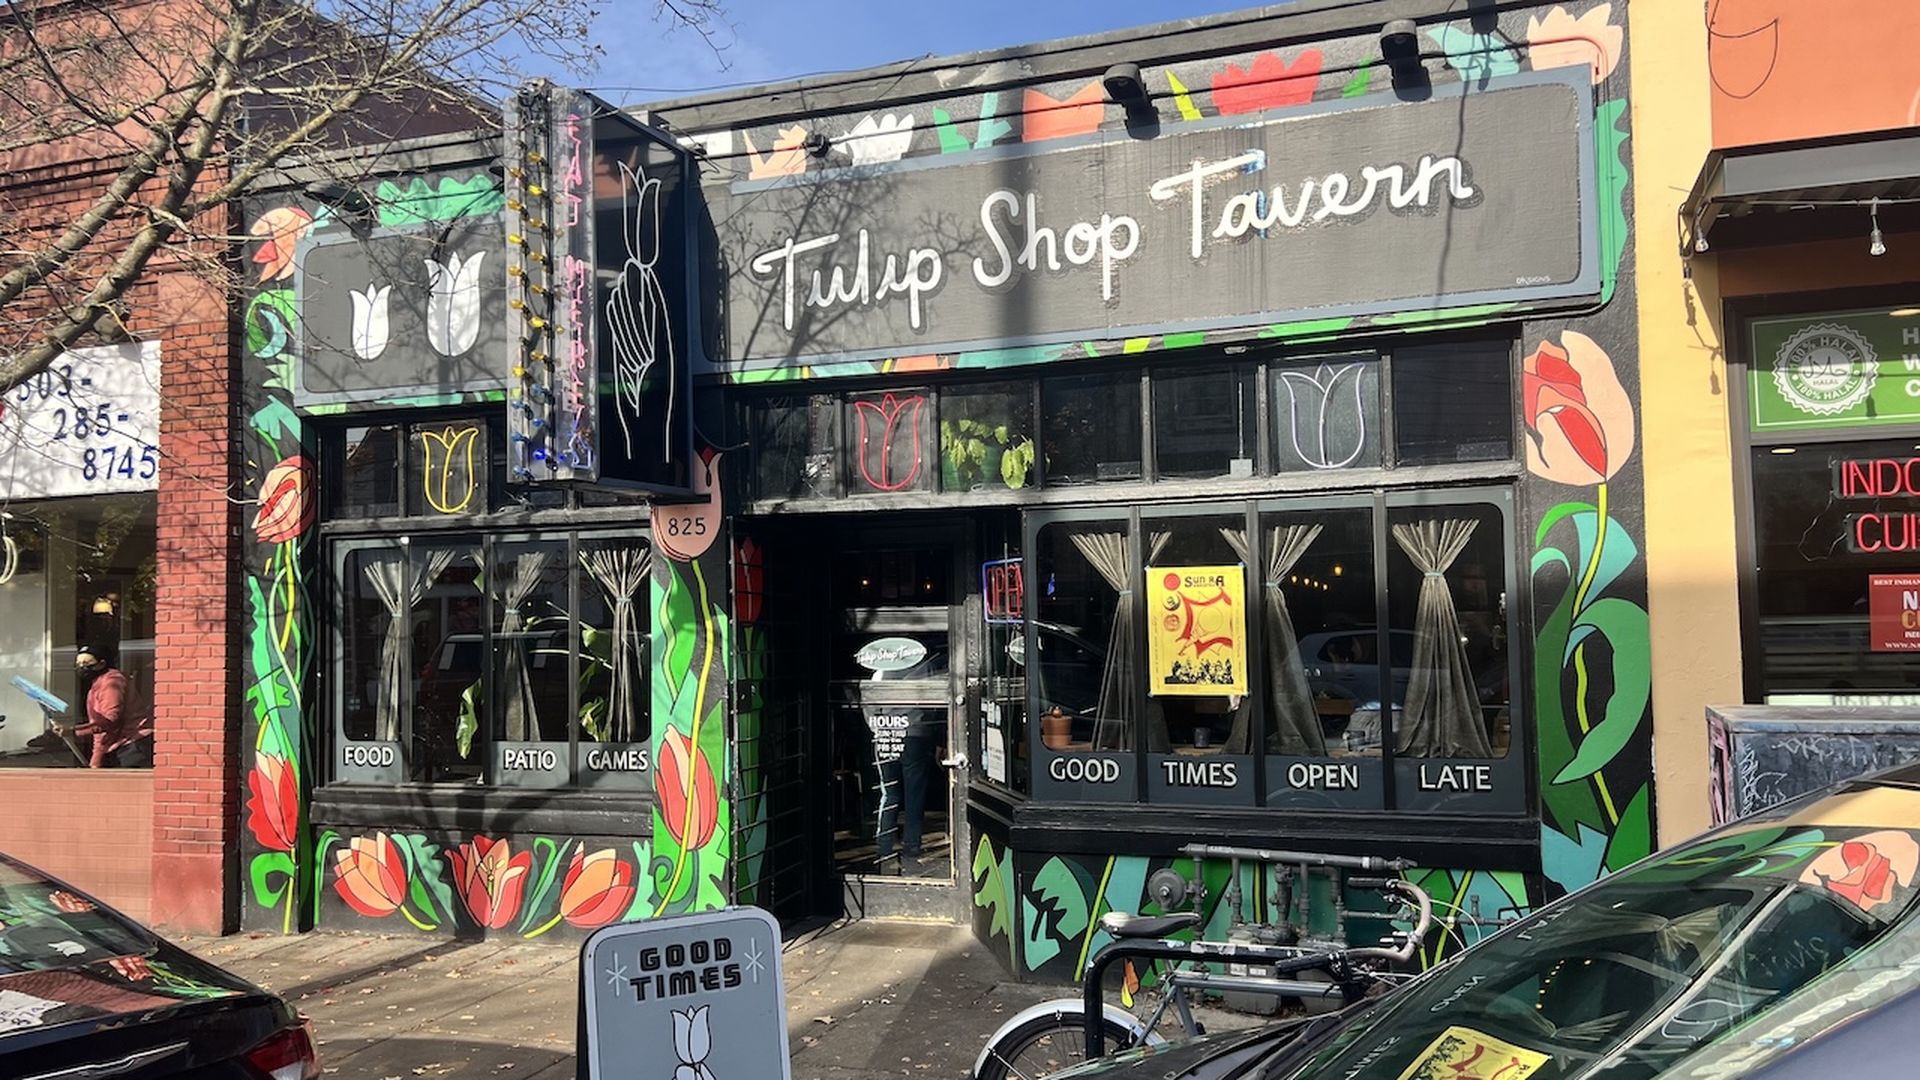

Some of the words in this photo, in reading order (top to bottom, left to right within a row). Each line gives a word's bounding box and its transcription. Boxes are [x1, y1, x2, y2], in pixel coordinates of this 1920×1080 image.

[752, 229, 943, 330] Tulip
[973, 190, 1139, 301] Shop
[1150, 149, 1474, 258] Tavern
[1820, 337, 1861, 367] HALAL
[1823, 380, 1858, 400] HALAL
[53, 403, 129, 440] 285-
[83, 446, 157, 481] 8745
[668, 517, 706, 536] 825
[1856, 513, 1920, 552] CUI
[869, 715, 909, 728] HOURS
[344, 746, 394, 766] FOOD
[504, 749, 556, 770] PATIO
[588, 750, 648, 771] GAMES
[1050, 757, 1120, 782] GOOD
[1163, 761, 1238, 787] TIMES
[1288, 763, 1358, 788] OPEN
[1419, 765, 1492, 790] LATE
[640, 937, 732, 971] GOOD
[630, 963, 741, 1001] TIMES
